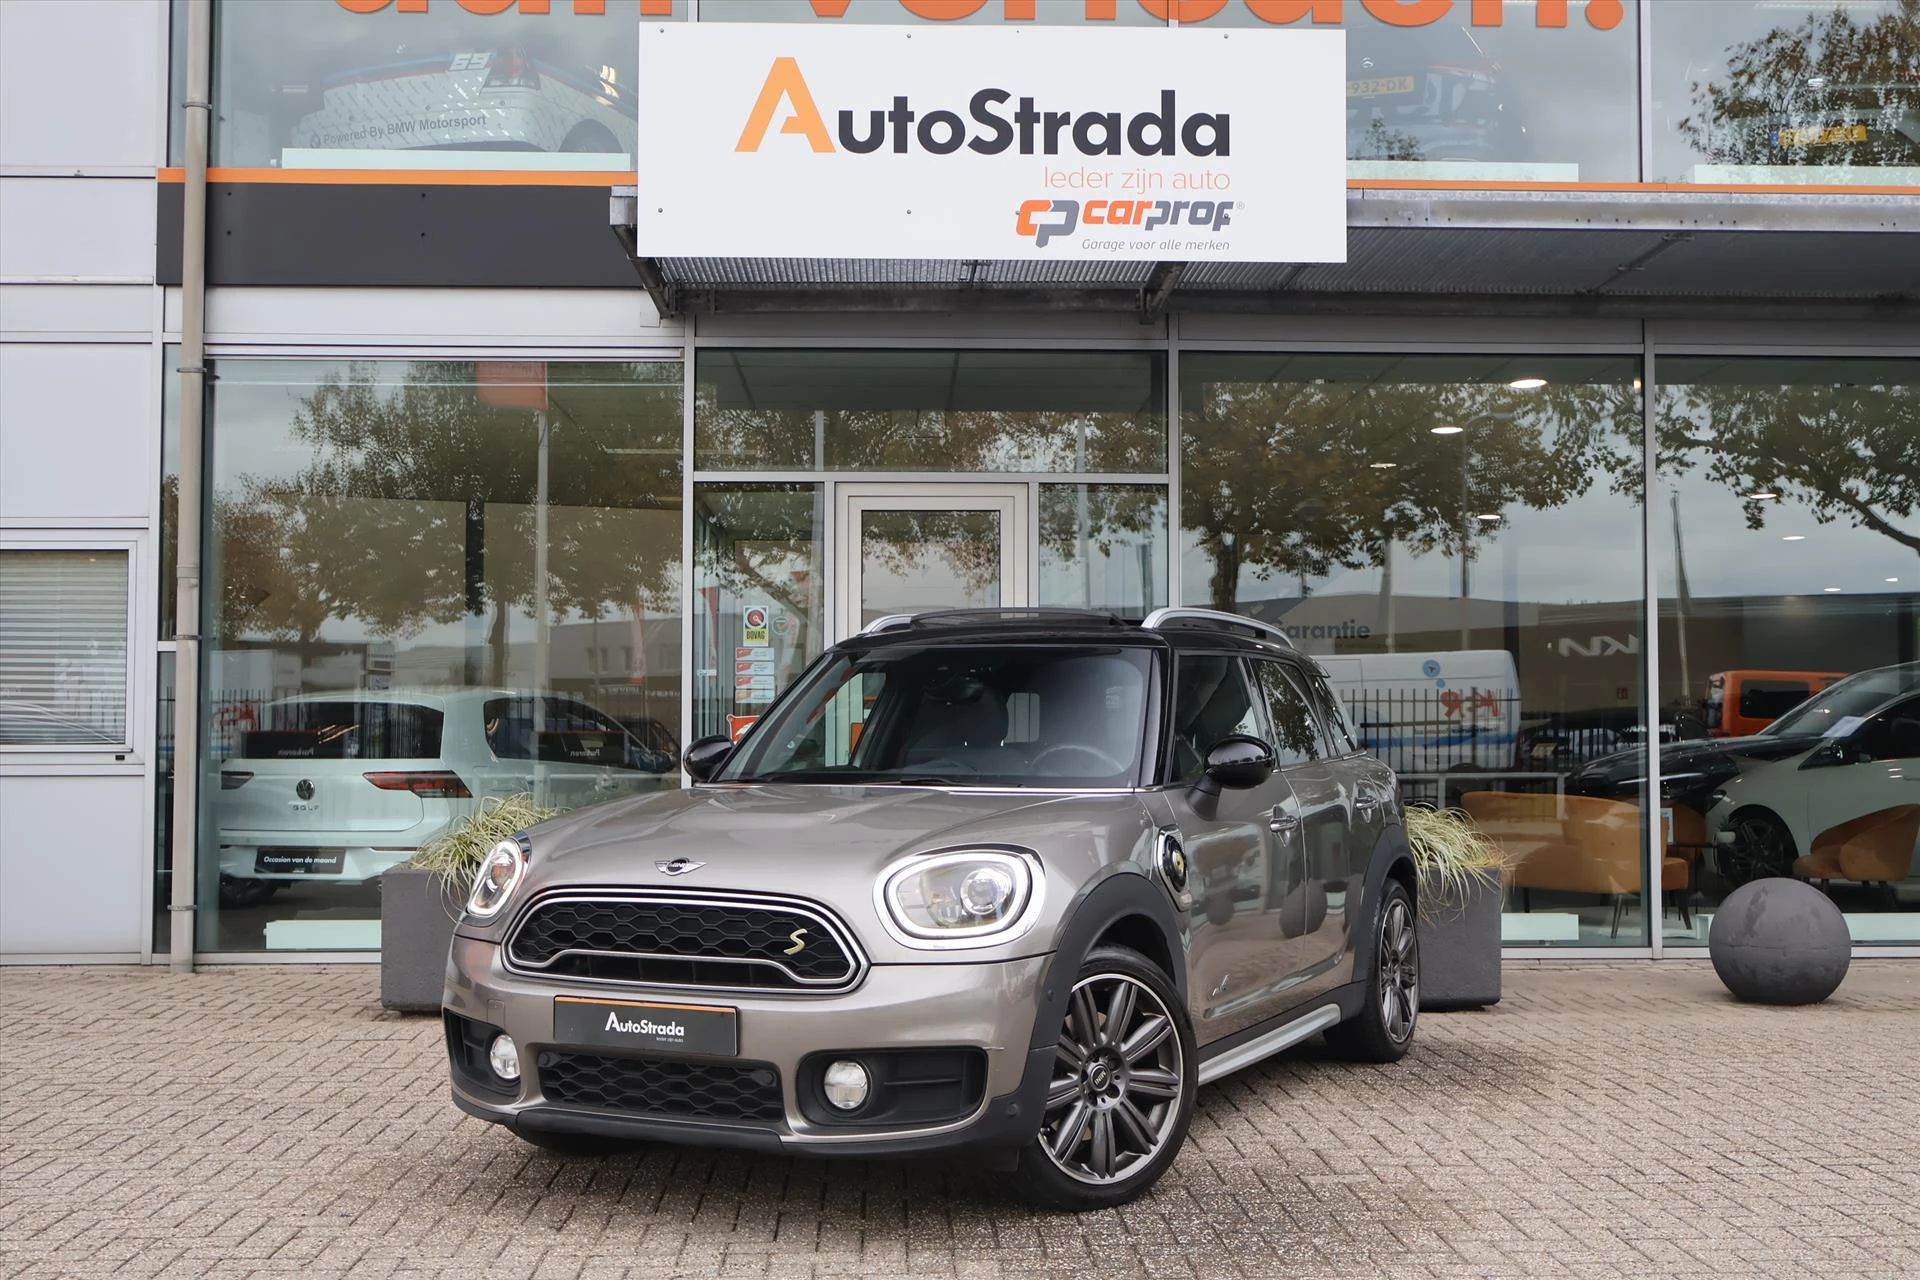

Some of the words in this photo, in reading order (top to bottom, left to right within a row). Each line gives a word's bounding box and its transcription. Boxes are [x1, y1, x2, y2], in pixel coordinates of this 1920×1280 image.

[734, 56, 1230, 157] AutoStrada
[323, 127, 368, 145] Powered
[369, 126, 384, 140] By
[386, 119, 416, 135] BMW
[419, 114, 487, 132] Motorsport
[1043, 166, 1113, 189] Ieder
[1121, 167, 1163, 195] zijn
[1172, 168, 1231, 190] auto
[1082, 238, 1126, 253] Garage
[1129, 240, 1157, 251] voor
[1159, 238, 1183, 251] alle
[1185, 239, 1231, 251] merken
[746, 630, 766, 640] BOVAG
[292, 804, 319, 812] GOLF
[263, 855, 291, 864] Occasion
[304, 856, 313, 864] de
[313, 856, 337, 864] maand
[604, 1011, 685, 1037] AutoStrada
